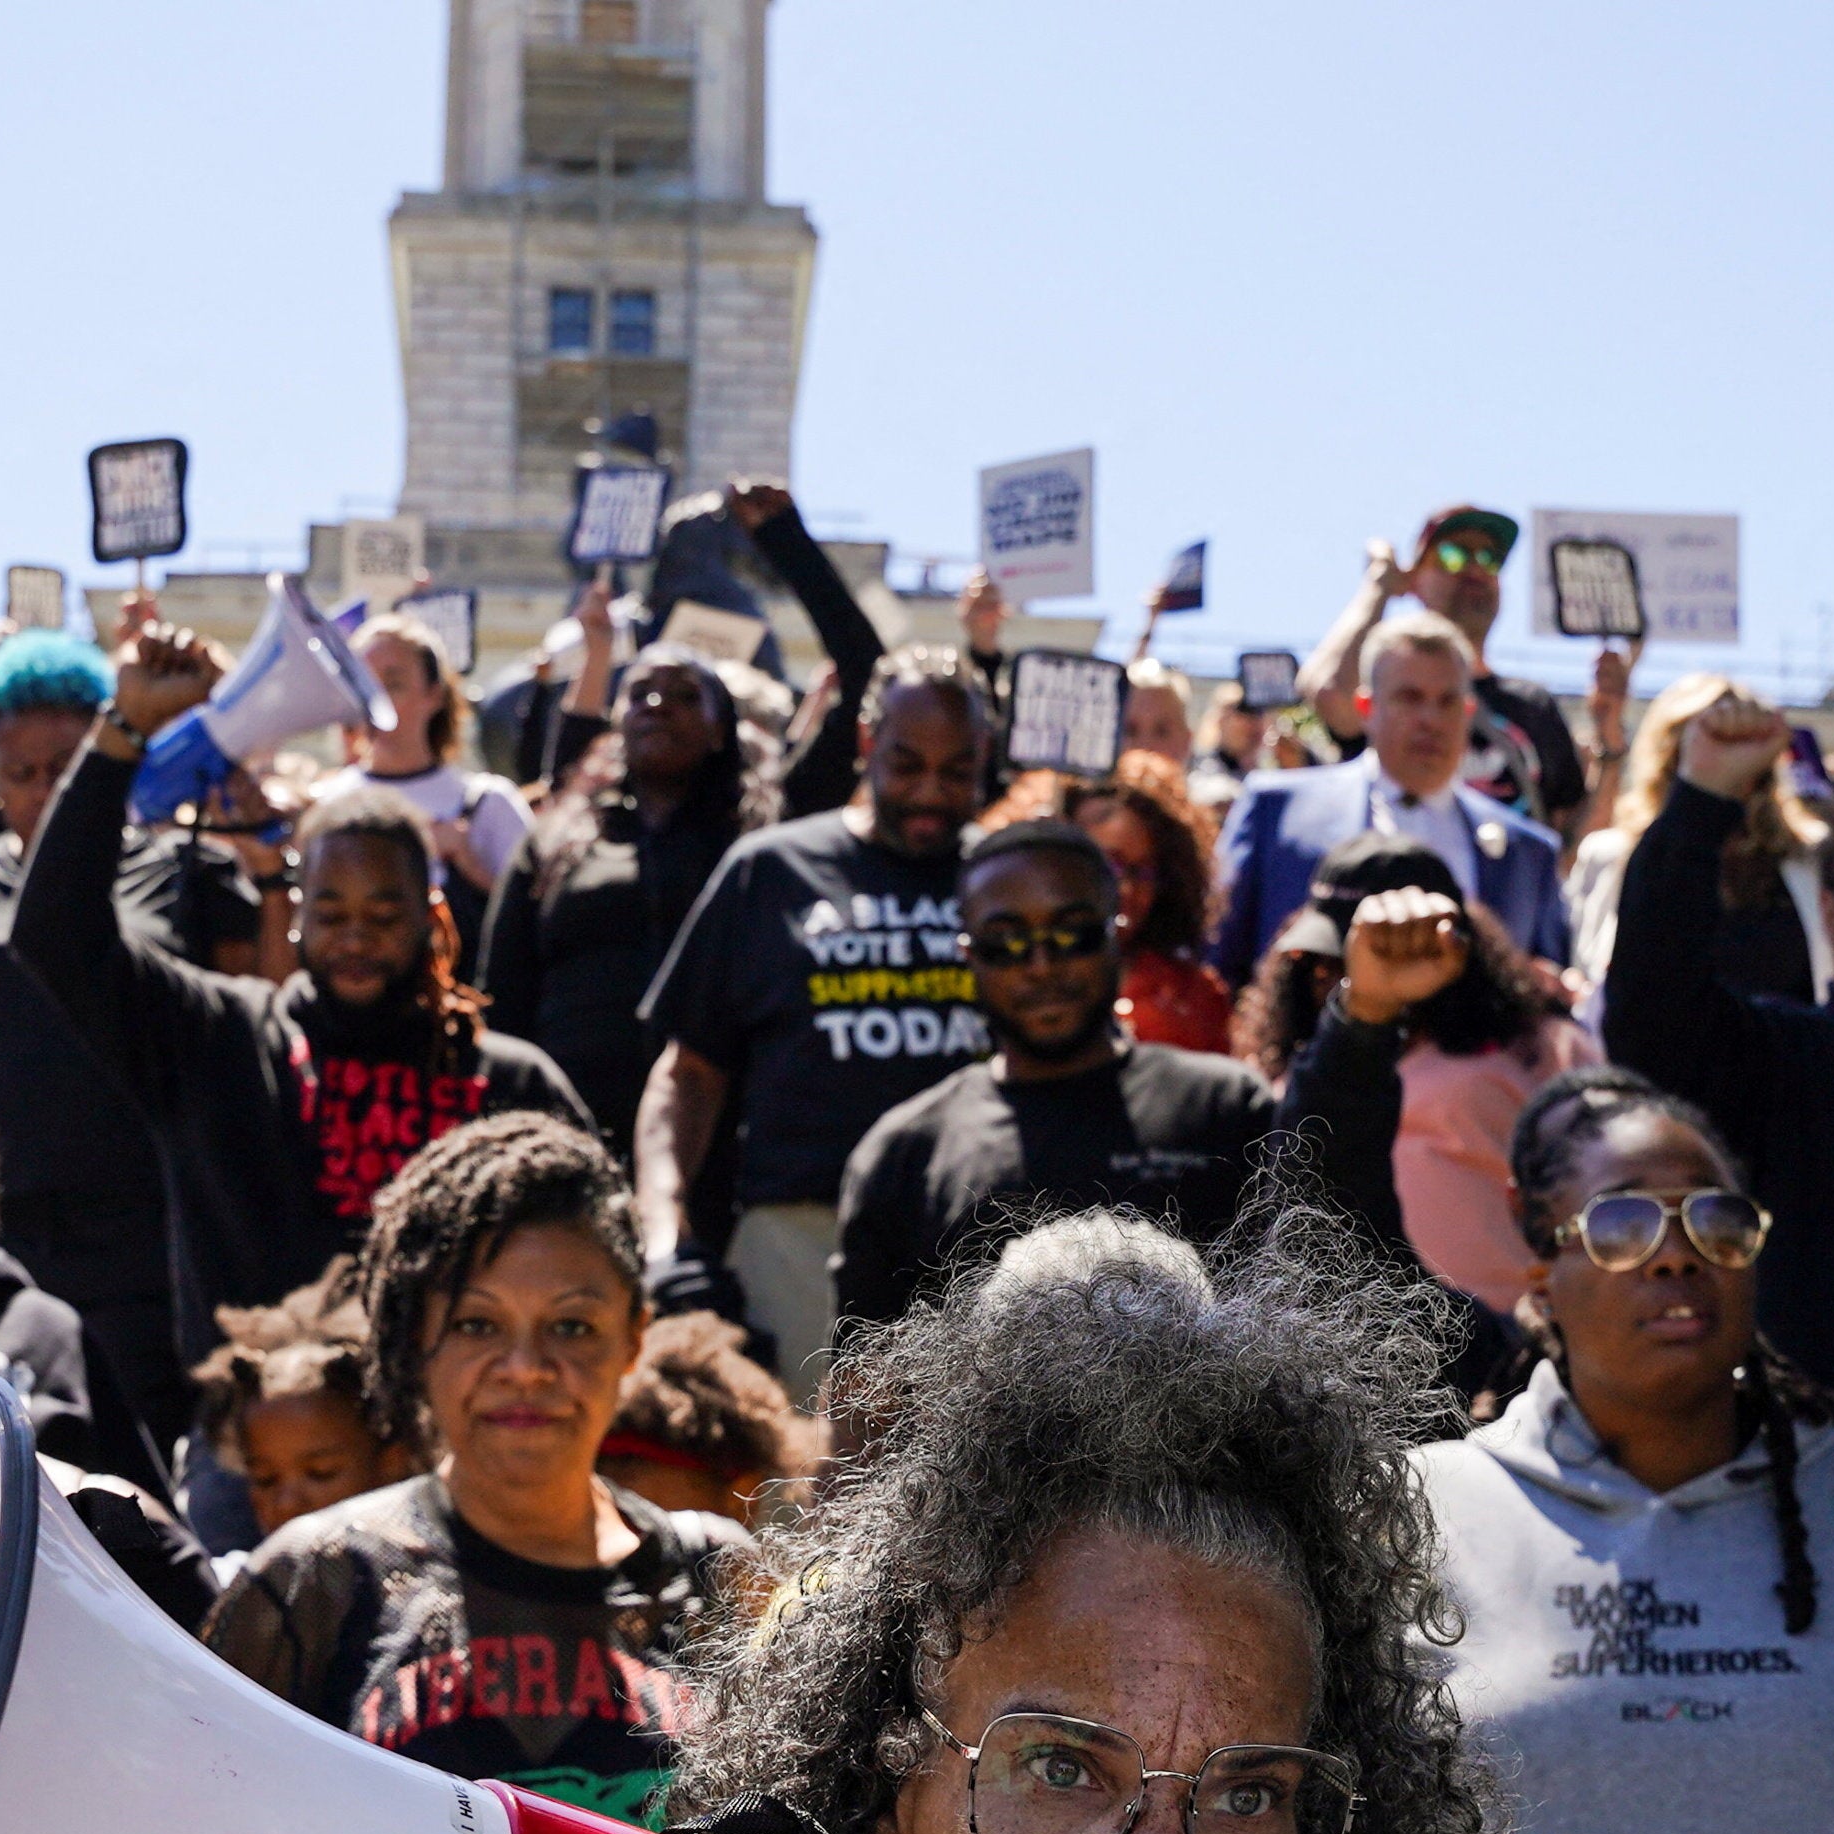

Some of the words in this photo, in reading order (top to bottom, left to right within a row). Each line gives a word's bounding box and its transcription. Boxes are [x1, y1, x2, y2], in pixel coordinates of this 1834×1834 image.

[802, 899, 846, 936] A
[850, 893, 965, 930] BLAC
[802, 928, 914, 967] VOTE
[1553, 1578, 1657, 1609] BLACK
[1569, 1602, 1701, 1631] WOMEN
[362, 1632, 682, 1750] LIBERA
[460, 1824, 475, 1832] I
